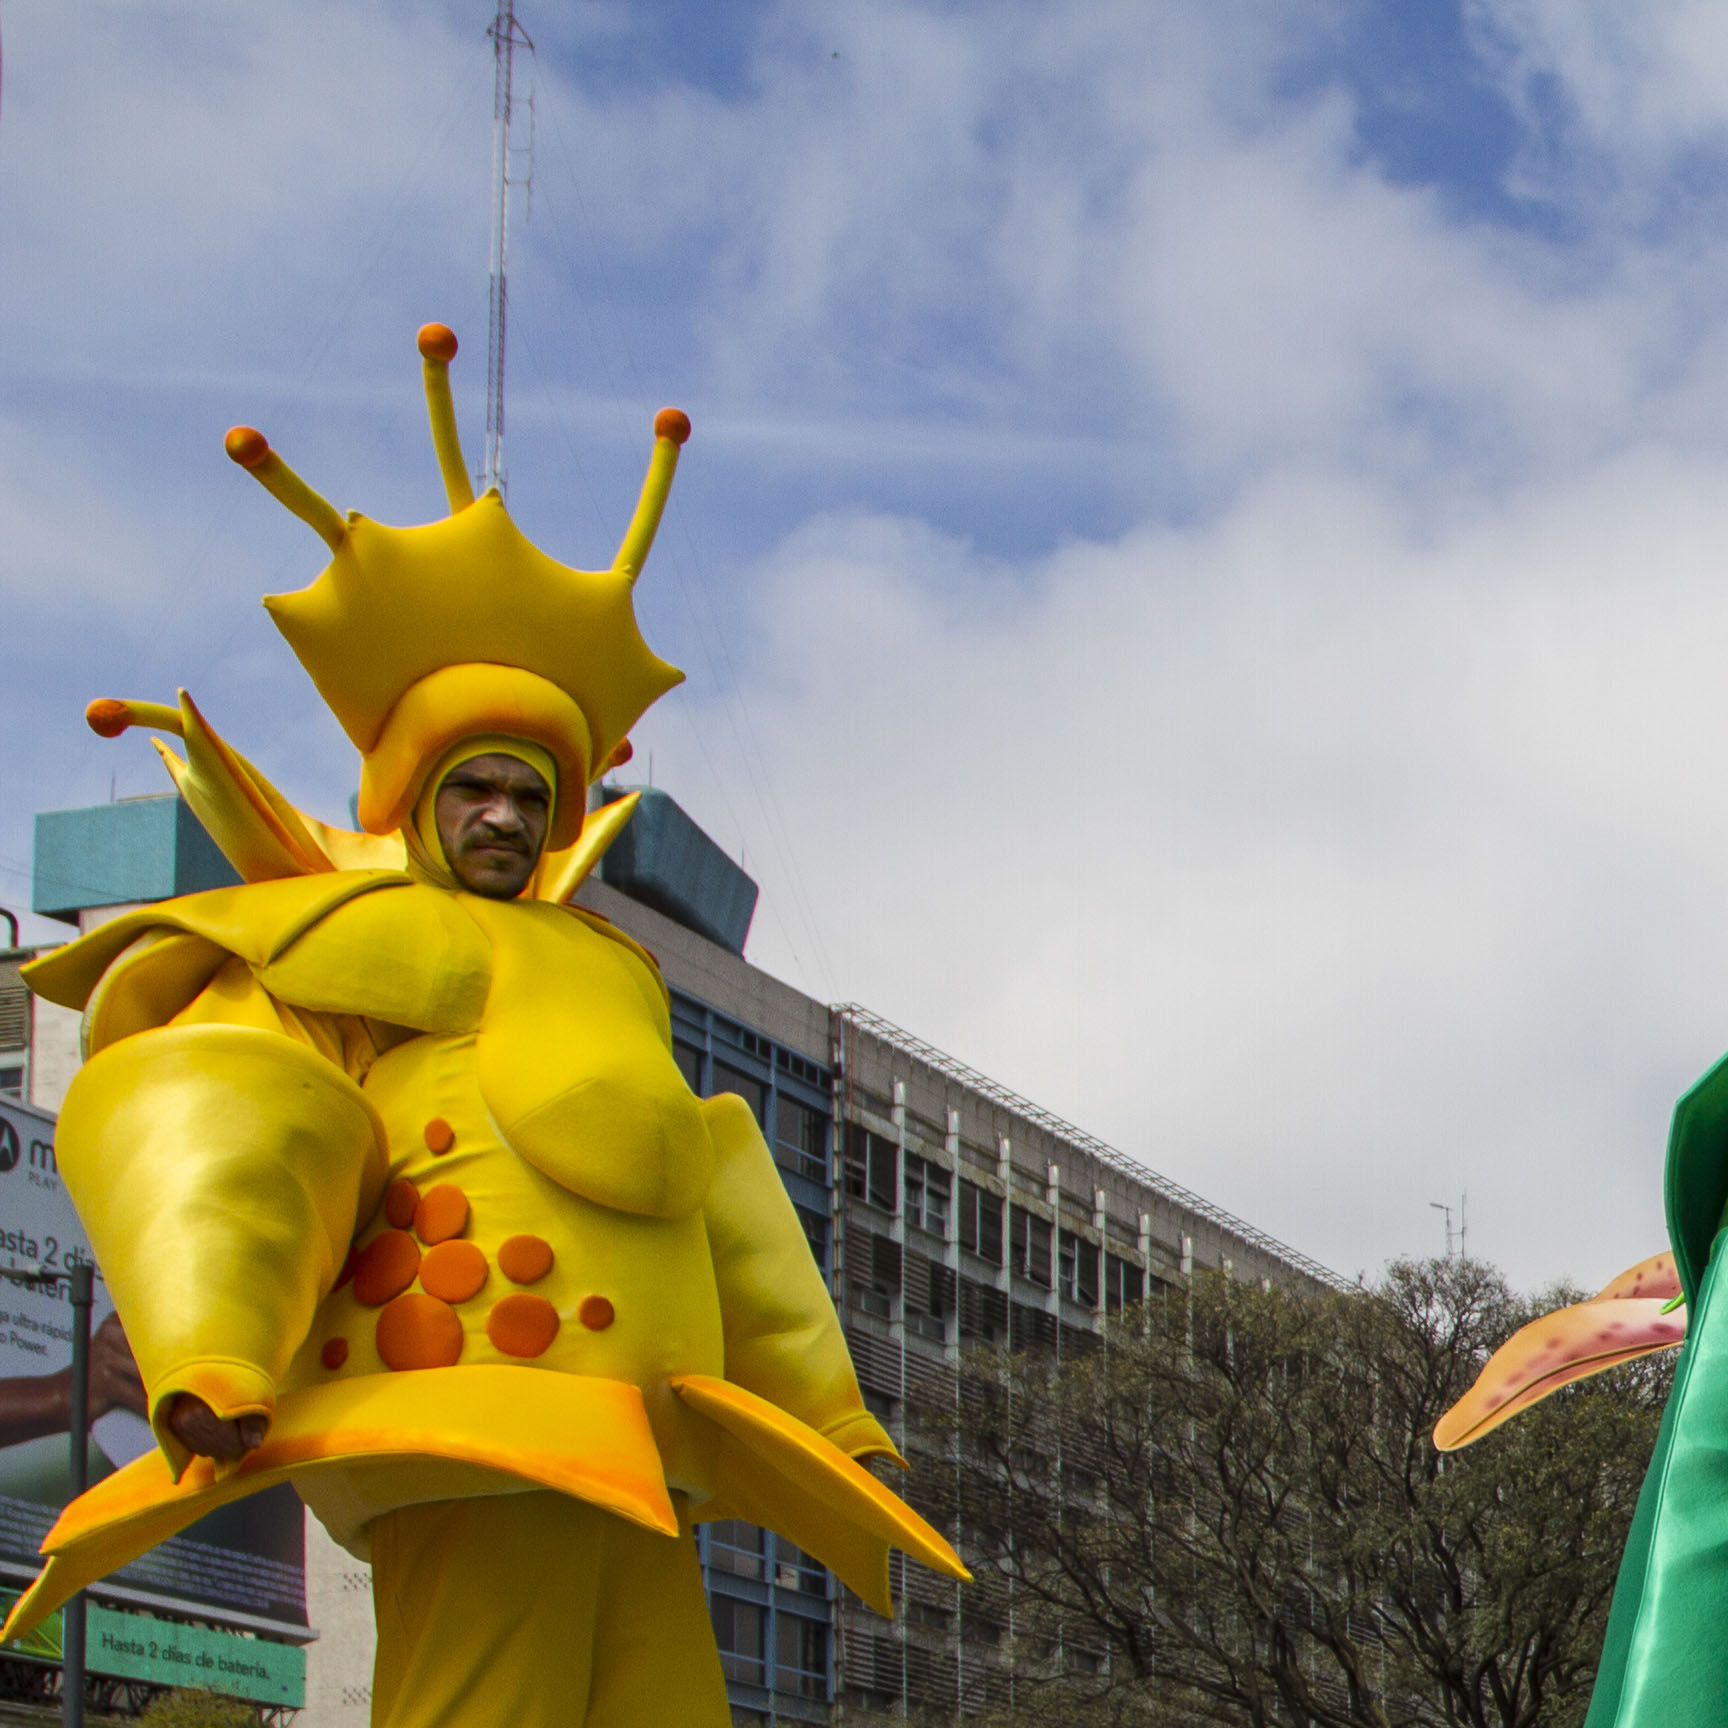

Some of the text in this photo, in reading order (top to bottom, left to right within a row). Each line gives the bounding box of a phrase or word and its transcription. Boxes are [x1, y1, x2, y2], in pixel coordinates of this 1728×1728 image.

[0, 1229, 38, 1258] asta
[45, 1236, 58, 1267] 2
[101, 1632, 145, 1657] Hasta
[148, 1640, 158, 1660] 2
[195, 1650, 215, 1669] de
